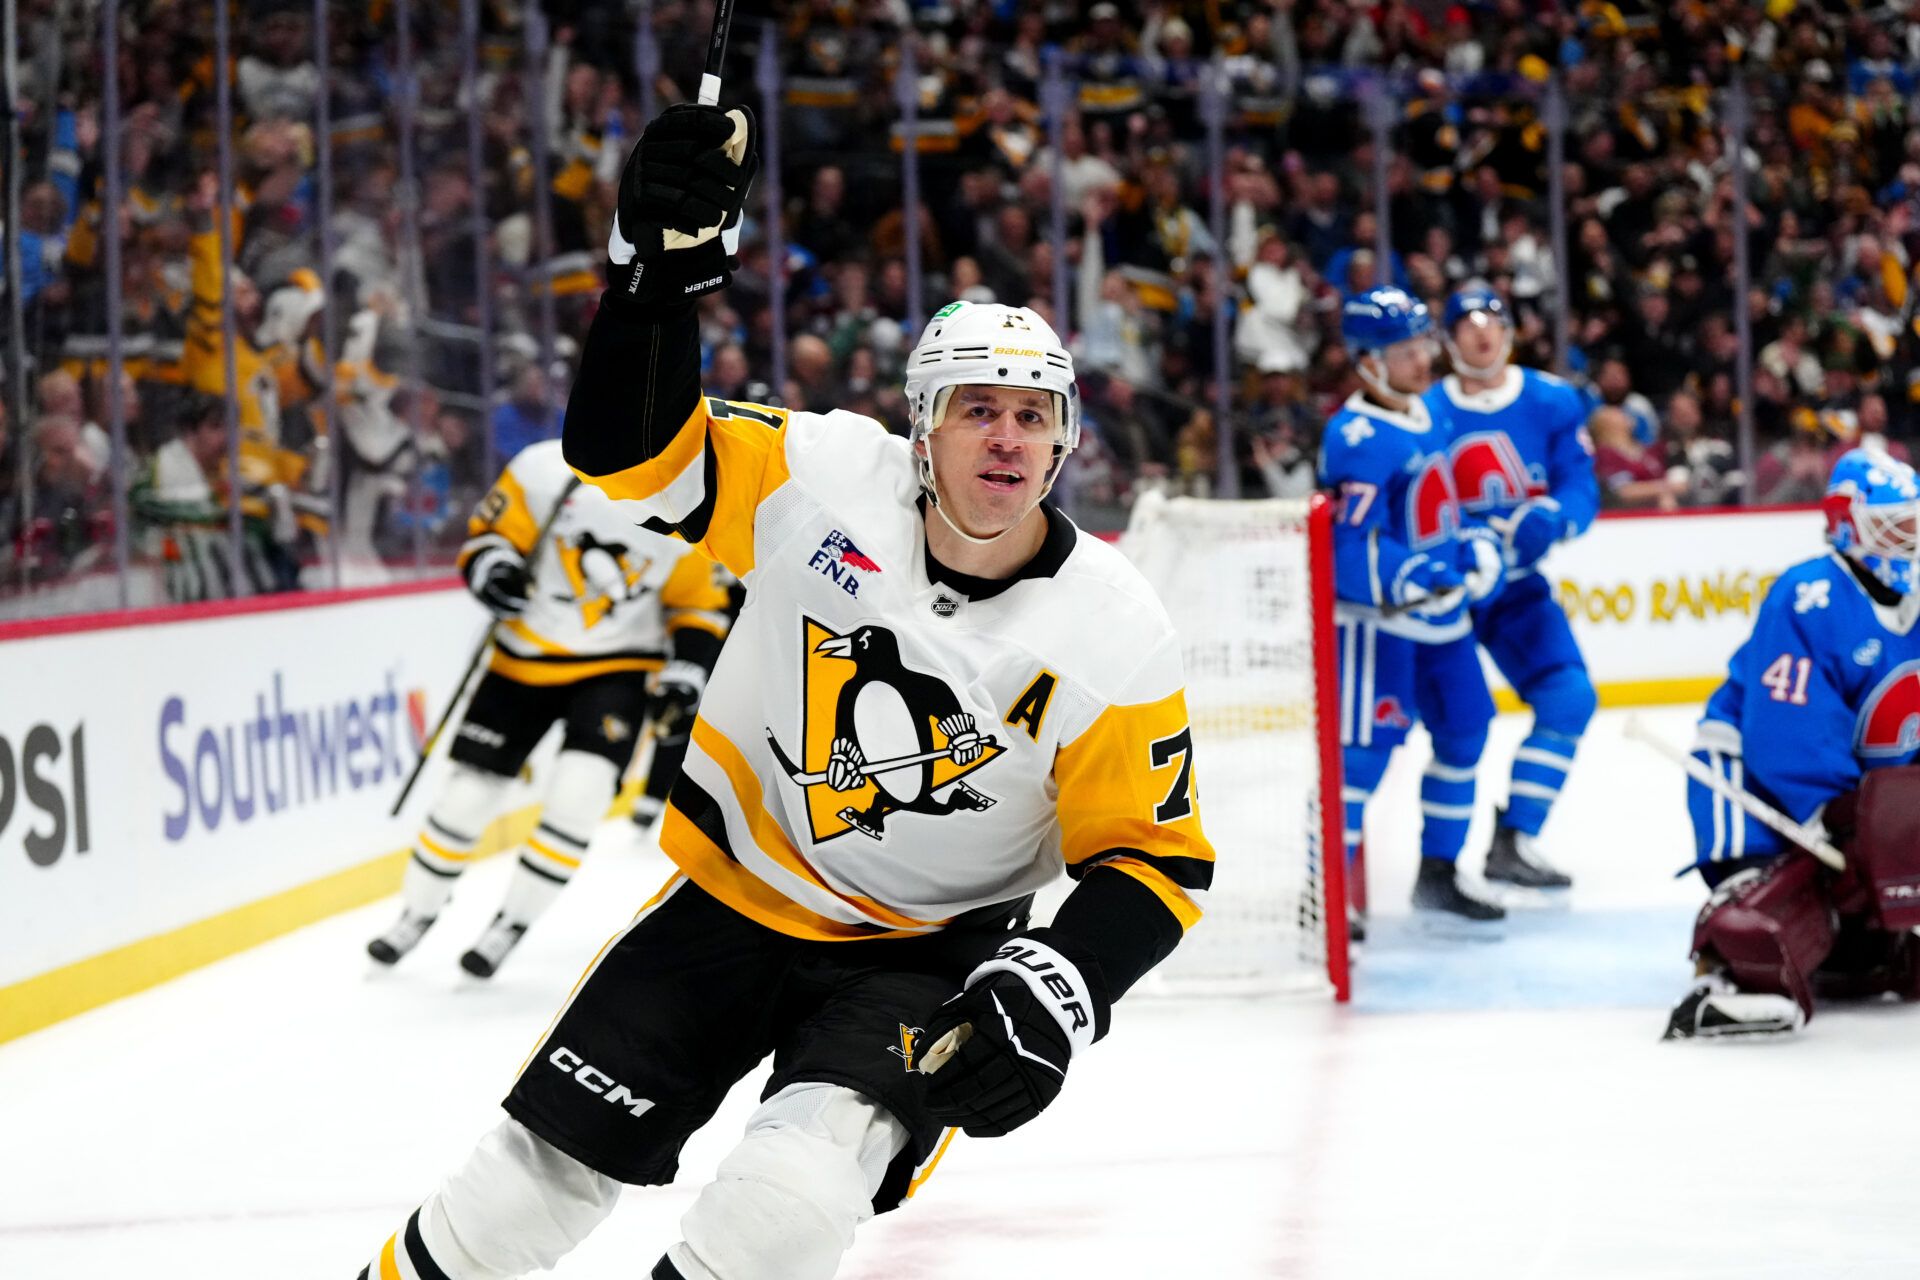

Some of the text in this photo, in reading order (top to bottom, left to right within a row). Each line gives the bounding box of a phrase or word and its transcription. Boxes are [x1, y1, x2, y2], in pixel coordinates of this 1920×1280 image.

[628, 261, 645, 294] MALKIN
[684, 275, 723, 294] BAUER
[993, 347, 1045, 359] BAUER
[807, 549, 860, 600] F.N.B.
[934, 603, 956, 612] NHL
[1003, 668, 1059, 743] A
[1760, 653, 1812, 706] 41
[159, 668, 404, 842] Southwest
[1148, 722, 1199, 826] 7
[990, 945, 1089, 1034] AUER
[549, 1046, 656, 1118] CCM
